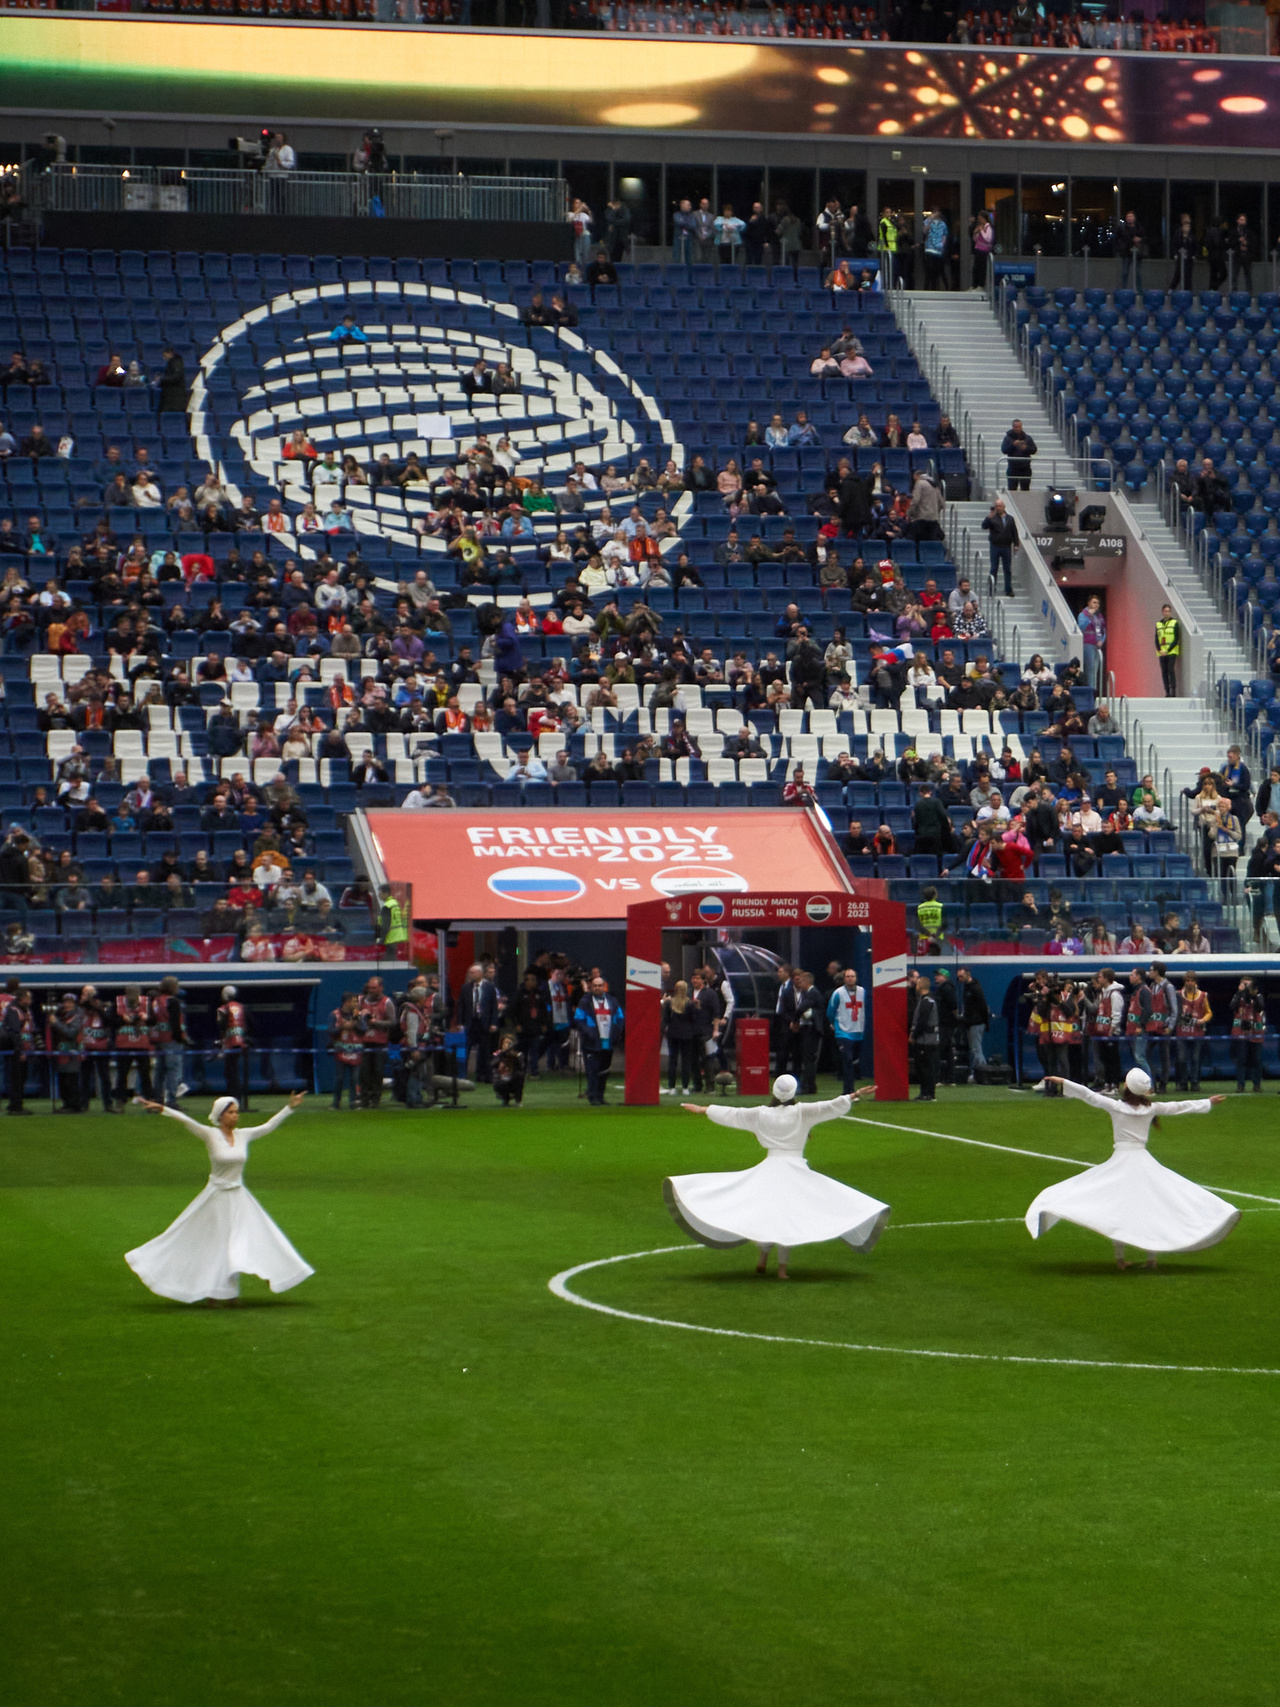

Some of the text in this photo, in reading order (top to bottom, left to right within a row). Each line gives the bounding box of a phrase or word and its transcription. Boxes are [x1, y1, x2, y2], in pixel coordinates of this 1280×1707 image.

[1034, 537, 1053, 546] 107
[1099, 538, 1123, 547] A108
[466, 826, 719, 845] FRIENDLY
[473, 845, 734, 862] MATCH 2023
[732, 898, 799, 906] FRIENDLY MATCH
[847, 902, 869, 910] 26.03
[732, 908, 765, 917] RUSSIA
[776, 908, 799, 919] IRAQ
[847, 910, 869, 918] 2023
